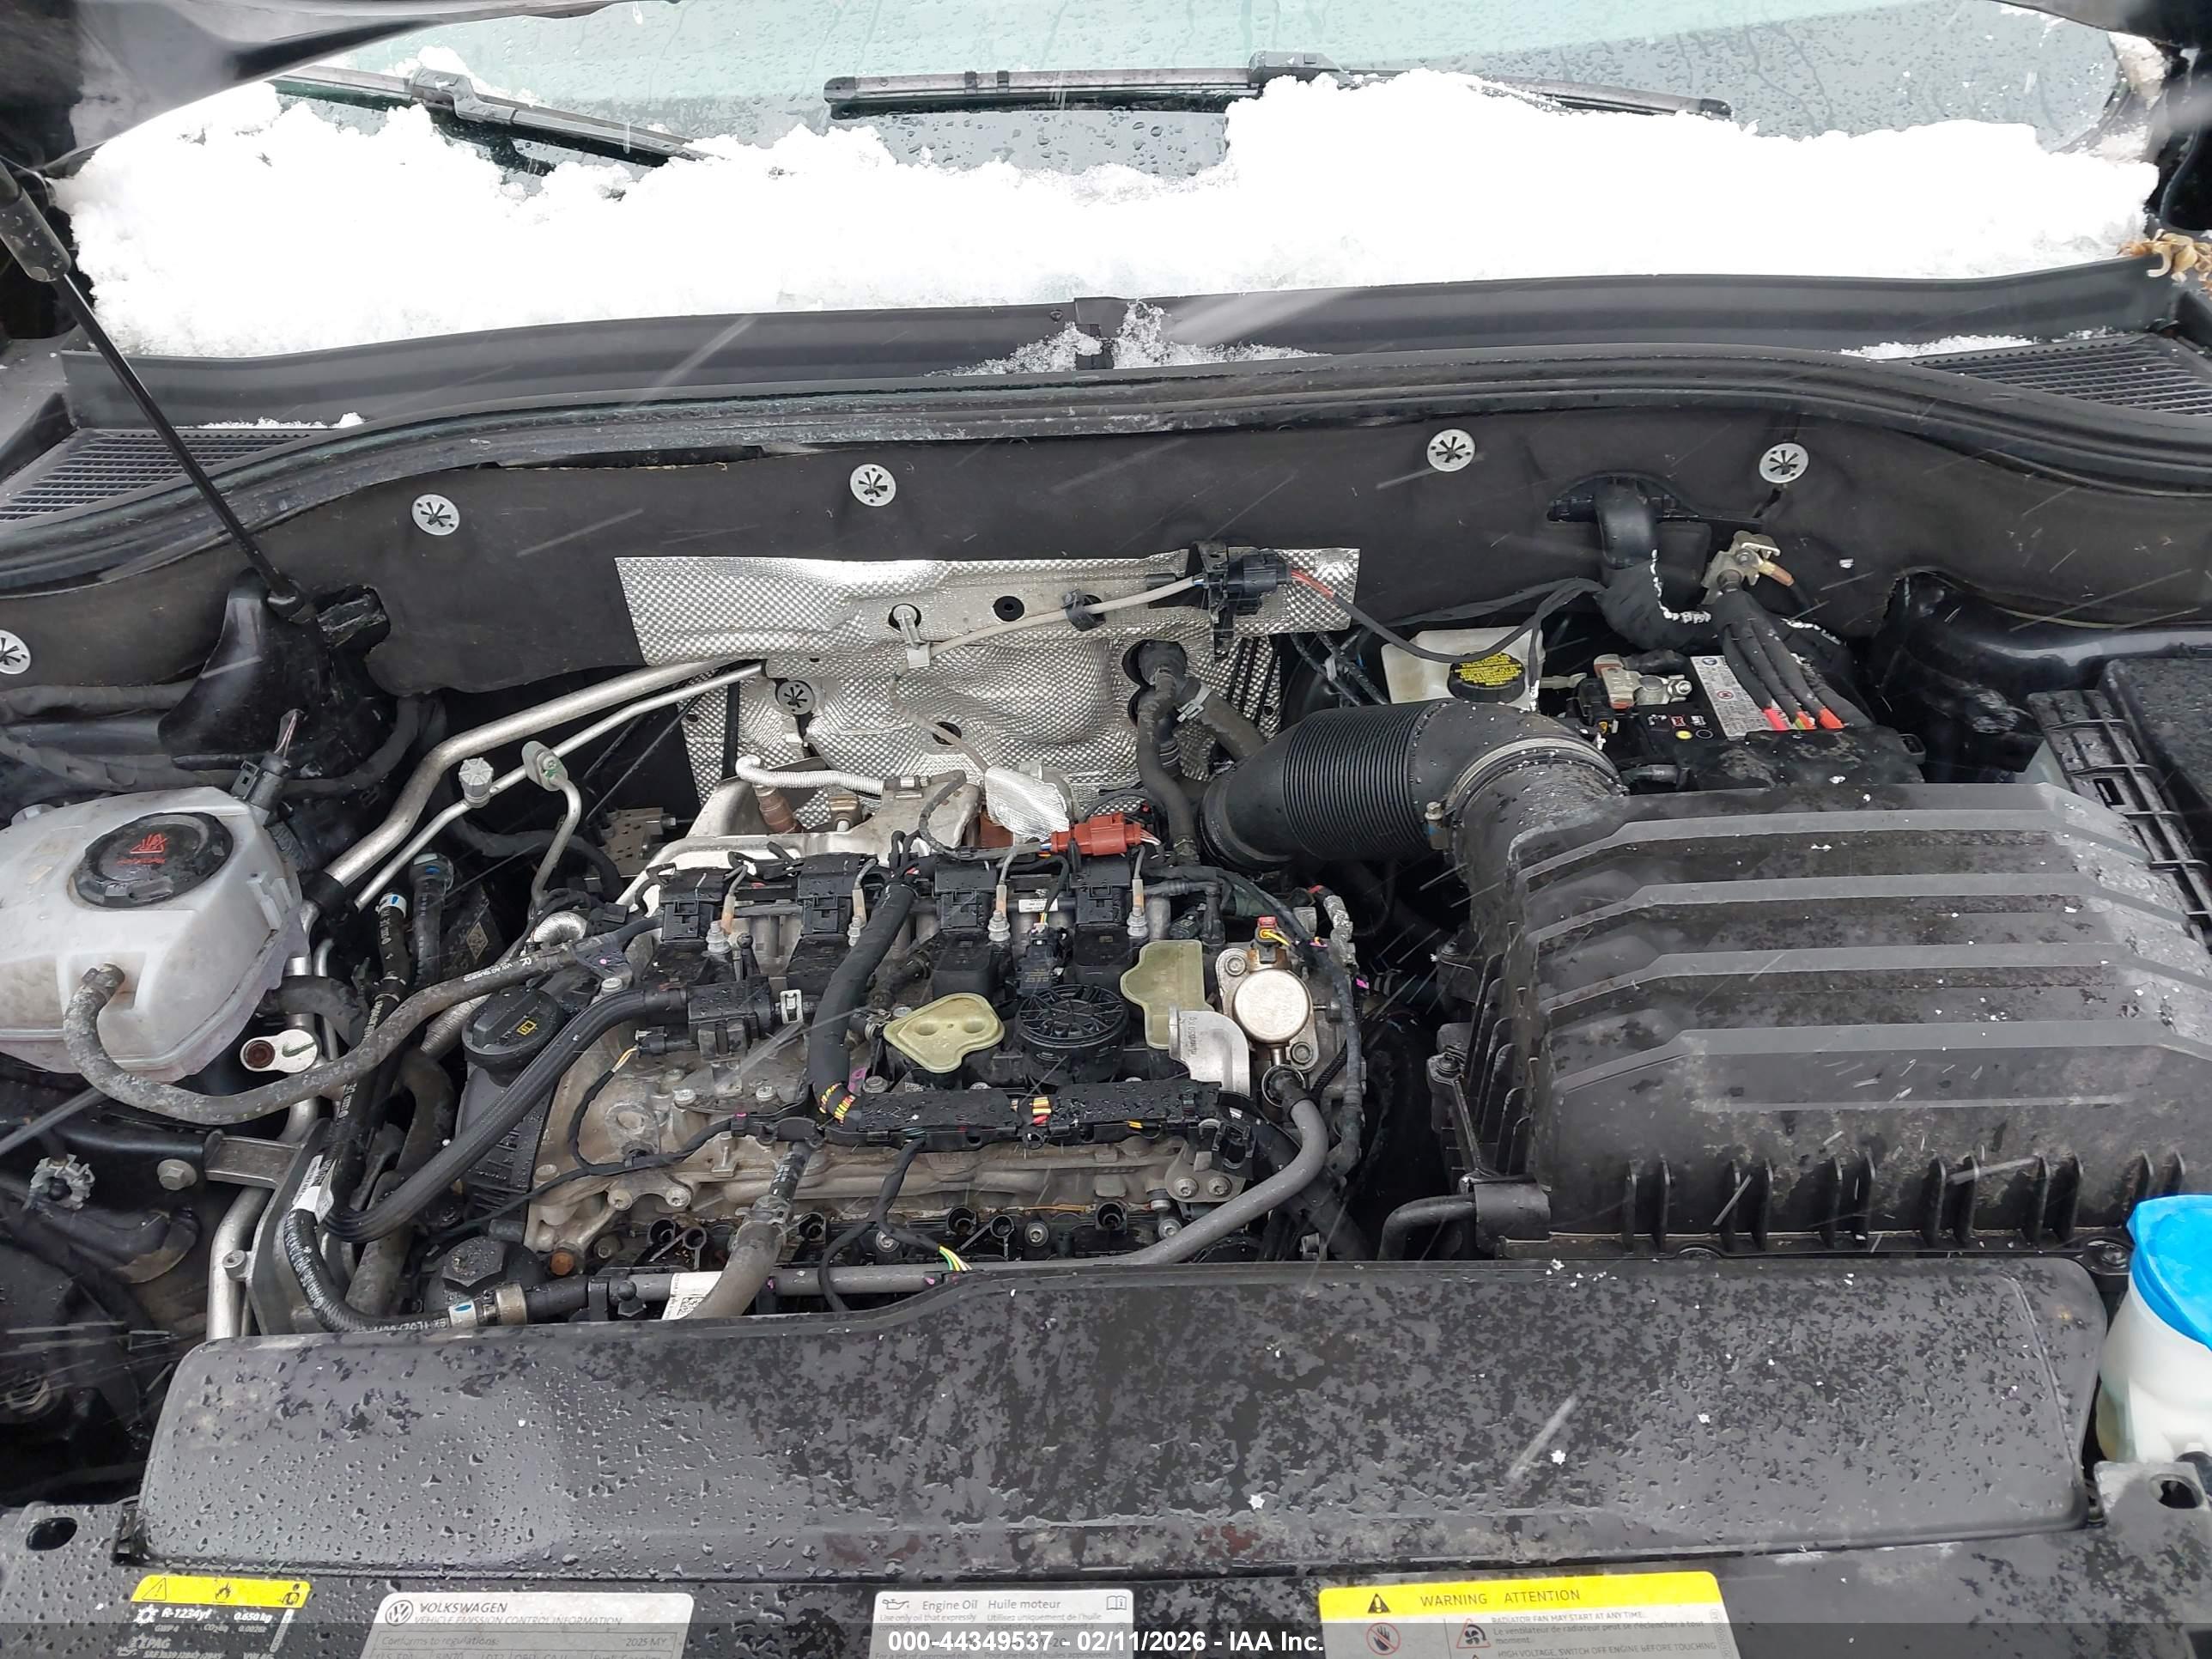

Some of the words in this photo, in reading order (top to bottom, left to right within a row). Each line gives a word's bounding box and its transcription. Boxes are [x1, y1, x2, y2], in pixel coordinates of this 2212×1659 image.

[1420, 1593, 1488, 1607] WARNING
[1504, 1589, 1581, 1604] ATTENTION
[420, 1602, 508, 1613] VOLKSWAGEN
[922, 1601, 960, 1613] Engine
[962, 1600, 978, 1610] Oil
[988, 1599, 1018, 1609] Huile
[1019, 1600, 1061, 1609] moteur
[161, 1607, 213, 1621] R-1234yf
[259, 1613, 273, 1623] kg
[415, 1615, 455, 1625] VEHICLE
[456, 1615, 503, 1625] EMISSION
[505, 1615, 550, 1625] CONTROL
[550, 1615, 623, 1626] INFORMATION
[941, 1613, 976, 1623] expressly
[1066, 1613, 1077, 1621] de
[1551, 1613, 1567, 1622] MAY
[1567, 1613, 1594, 1621] START
[1595, 1612, 1604, 1620] AT
[1607, 1611, 1622, 1620] ANY
[1493, 1627, 1503, 1636] Le
[1505, 1626, 1549, 1635] ventilateur
[1551, 1625, 1561, 1633] de
[1563, 1623, 1600, 1632] radiateur
[381, 1635, 428, 1645] Conforms
[430, 1635, 439, 1645] to
[626, 1638, 647, 1647] 2025
[1498, 1649, 1519, 1658] HIGH
[1559, 1647, 1591, 1656] SWITCH
[1592, 1646, 1607, 1655] OFF
[1608, 1644, 1642, 1654] ENGINE
[1674, 1641, 1717, 1651] TOUCHING
